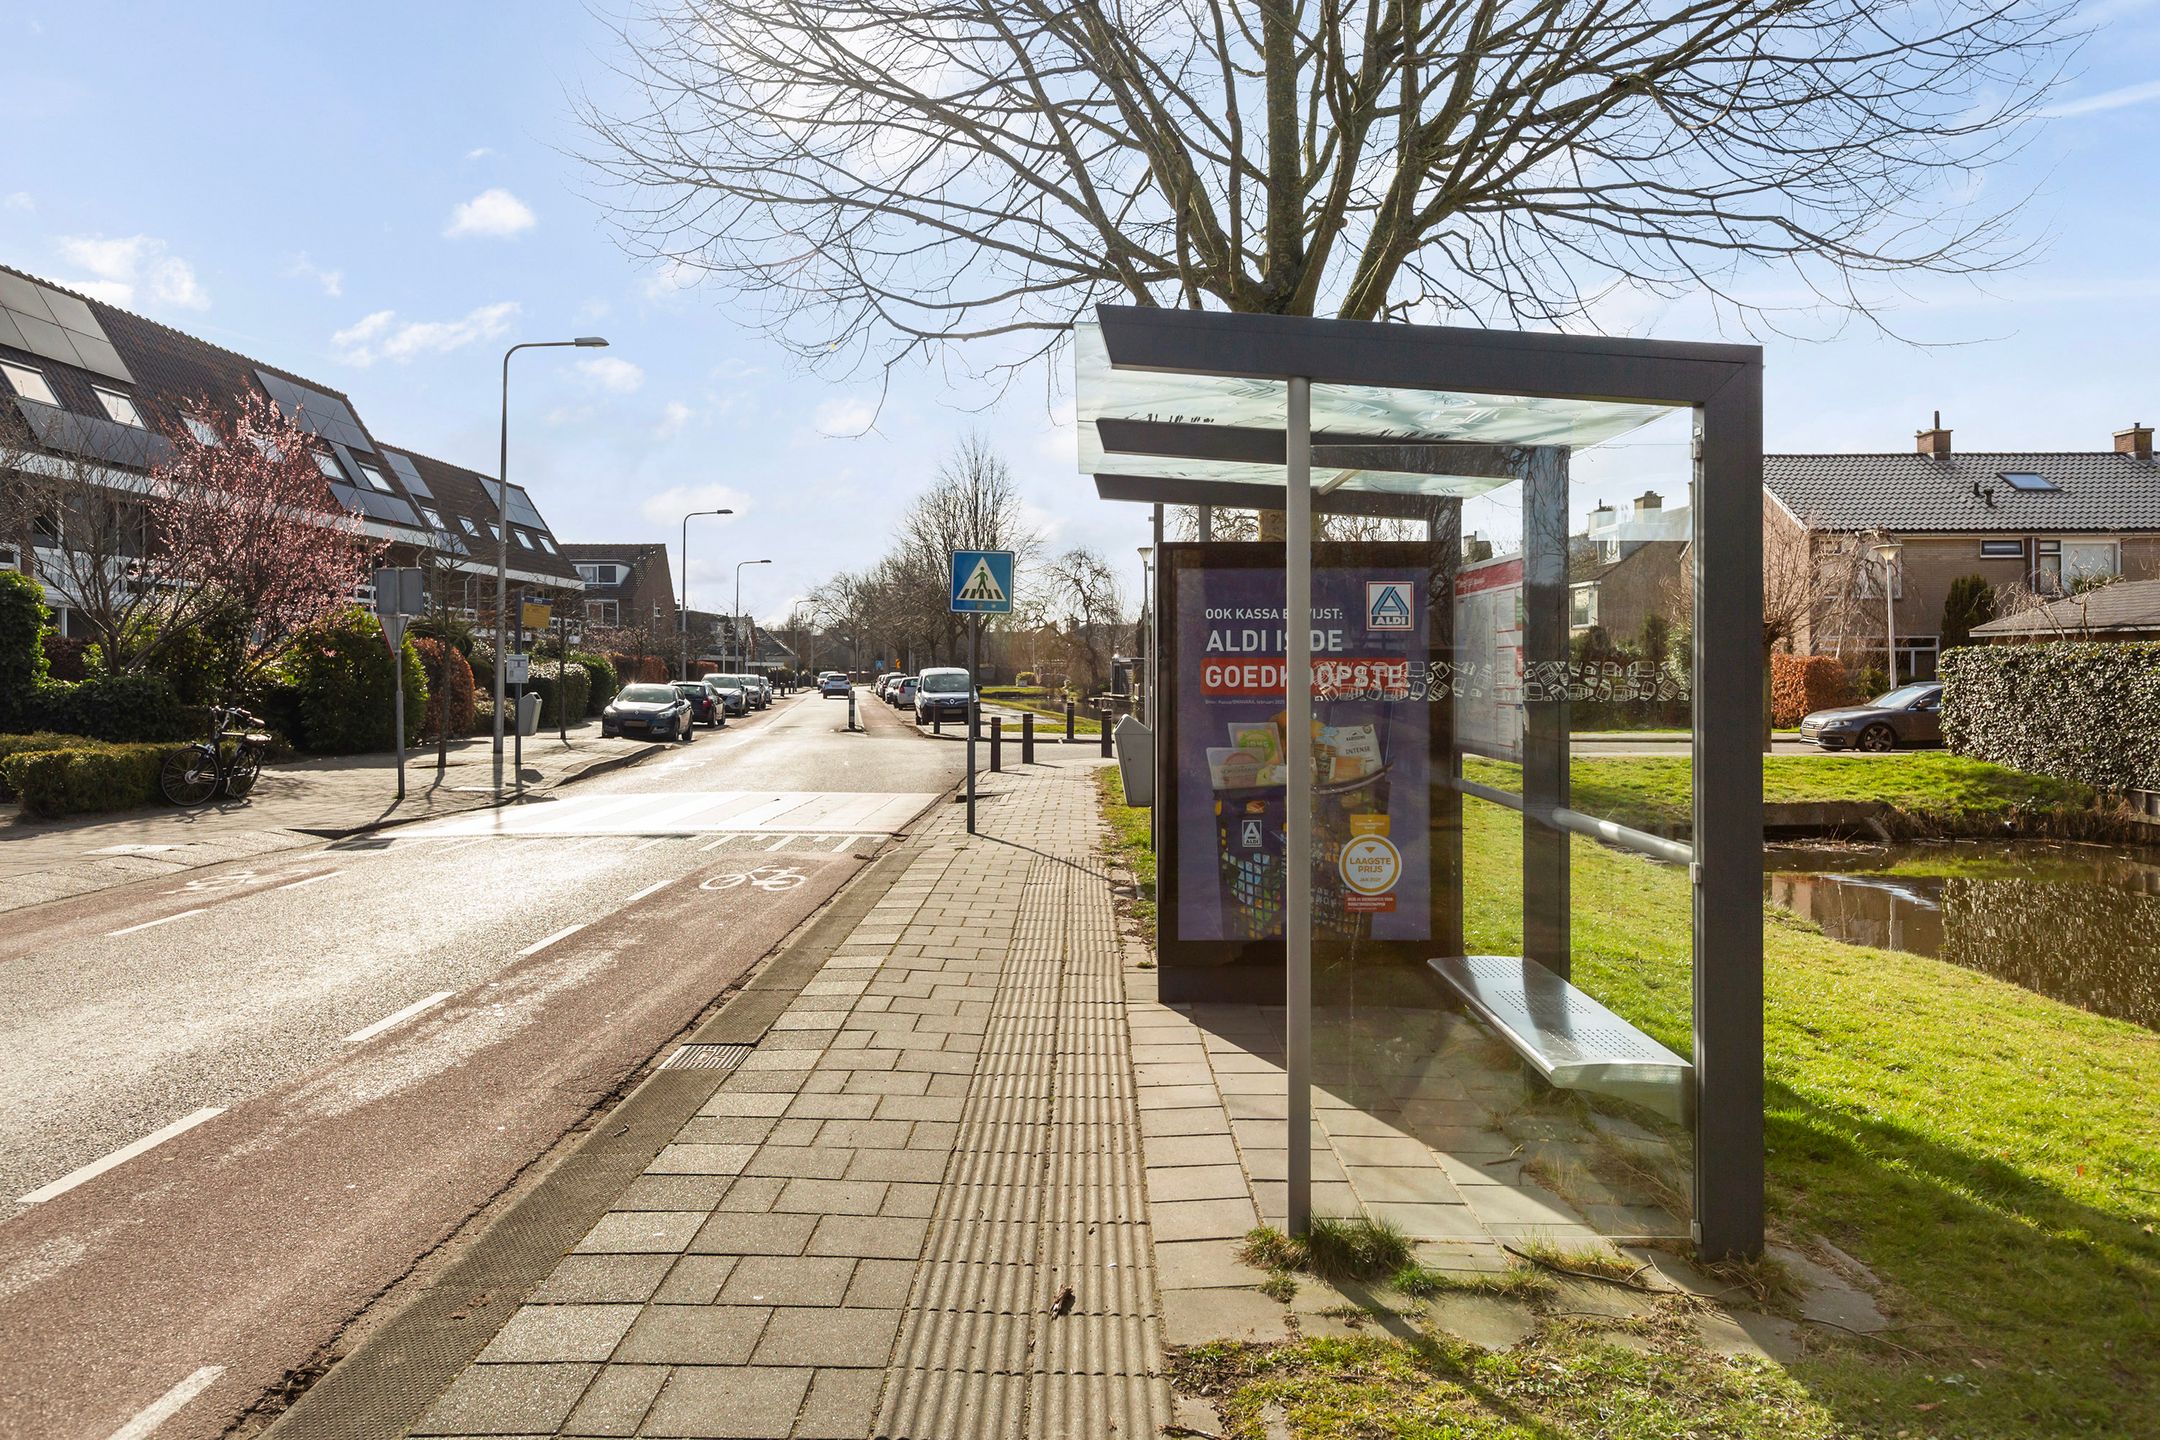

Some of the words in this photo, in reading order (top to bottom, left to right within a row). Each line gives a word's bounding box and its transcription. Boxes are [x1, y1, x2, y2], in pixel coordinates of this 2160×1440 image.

[1205, 608, 1232, 620] OOK
[1236, 608, 1279, 620] KASSA
[1283, 608, 1343, 620] IJST:
[1375, 616, 1406, 625] ALDI
[1206, 629, 1266, 652] ALDI
[1276, 629, 1288, 652] I
[1310, 629, 1343, 652] DE
[1205, 665, 1404, 688] GOEDOPSTE
[1345, 745, 1371, 755] INTENSE
[1349, 857, 1392, 865] LAAGSTE
[1357, 865, 1383, 873] PRIJS
